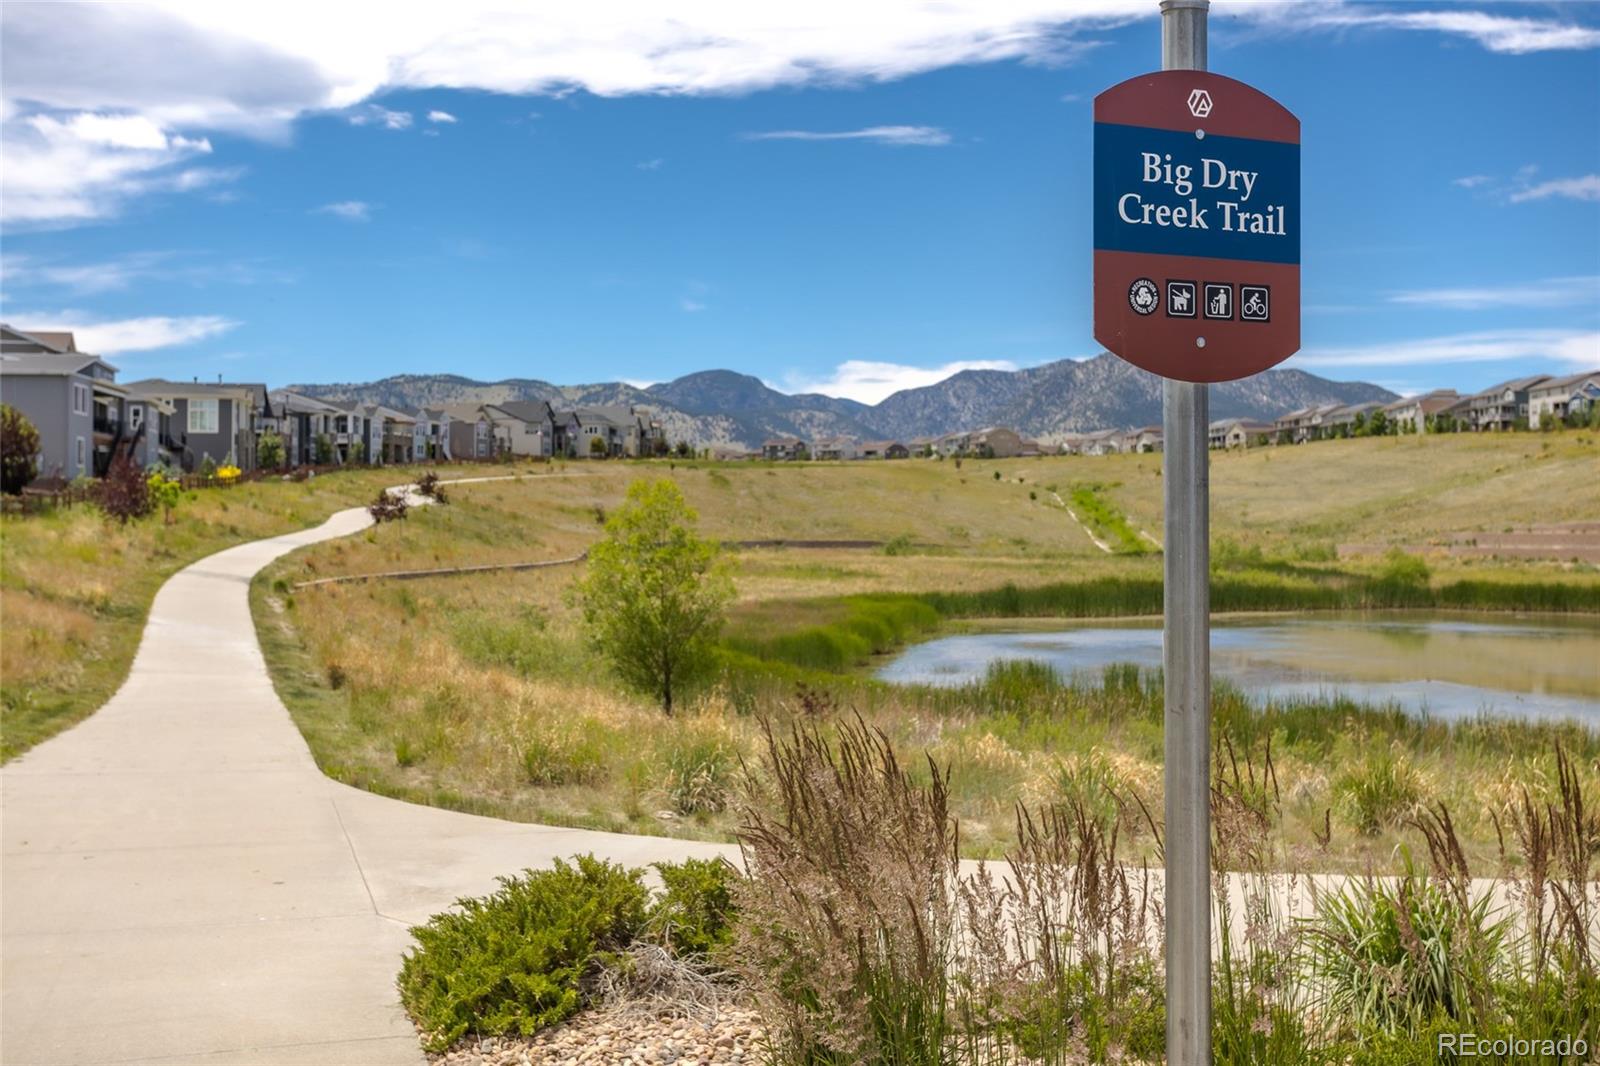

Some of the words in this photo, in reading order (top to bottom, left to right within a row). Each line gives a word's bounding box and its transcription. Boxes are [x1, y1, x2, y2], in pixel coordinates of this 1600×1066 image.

[1141, 152, 1193, 196] Big
[1200, 158, 1259, 201] Dry
[1118, 193, 1209, 230] Creek
[1216, 201, 1287, 235] Trail
